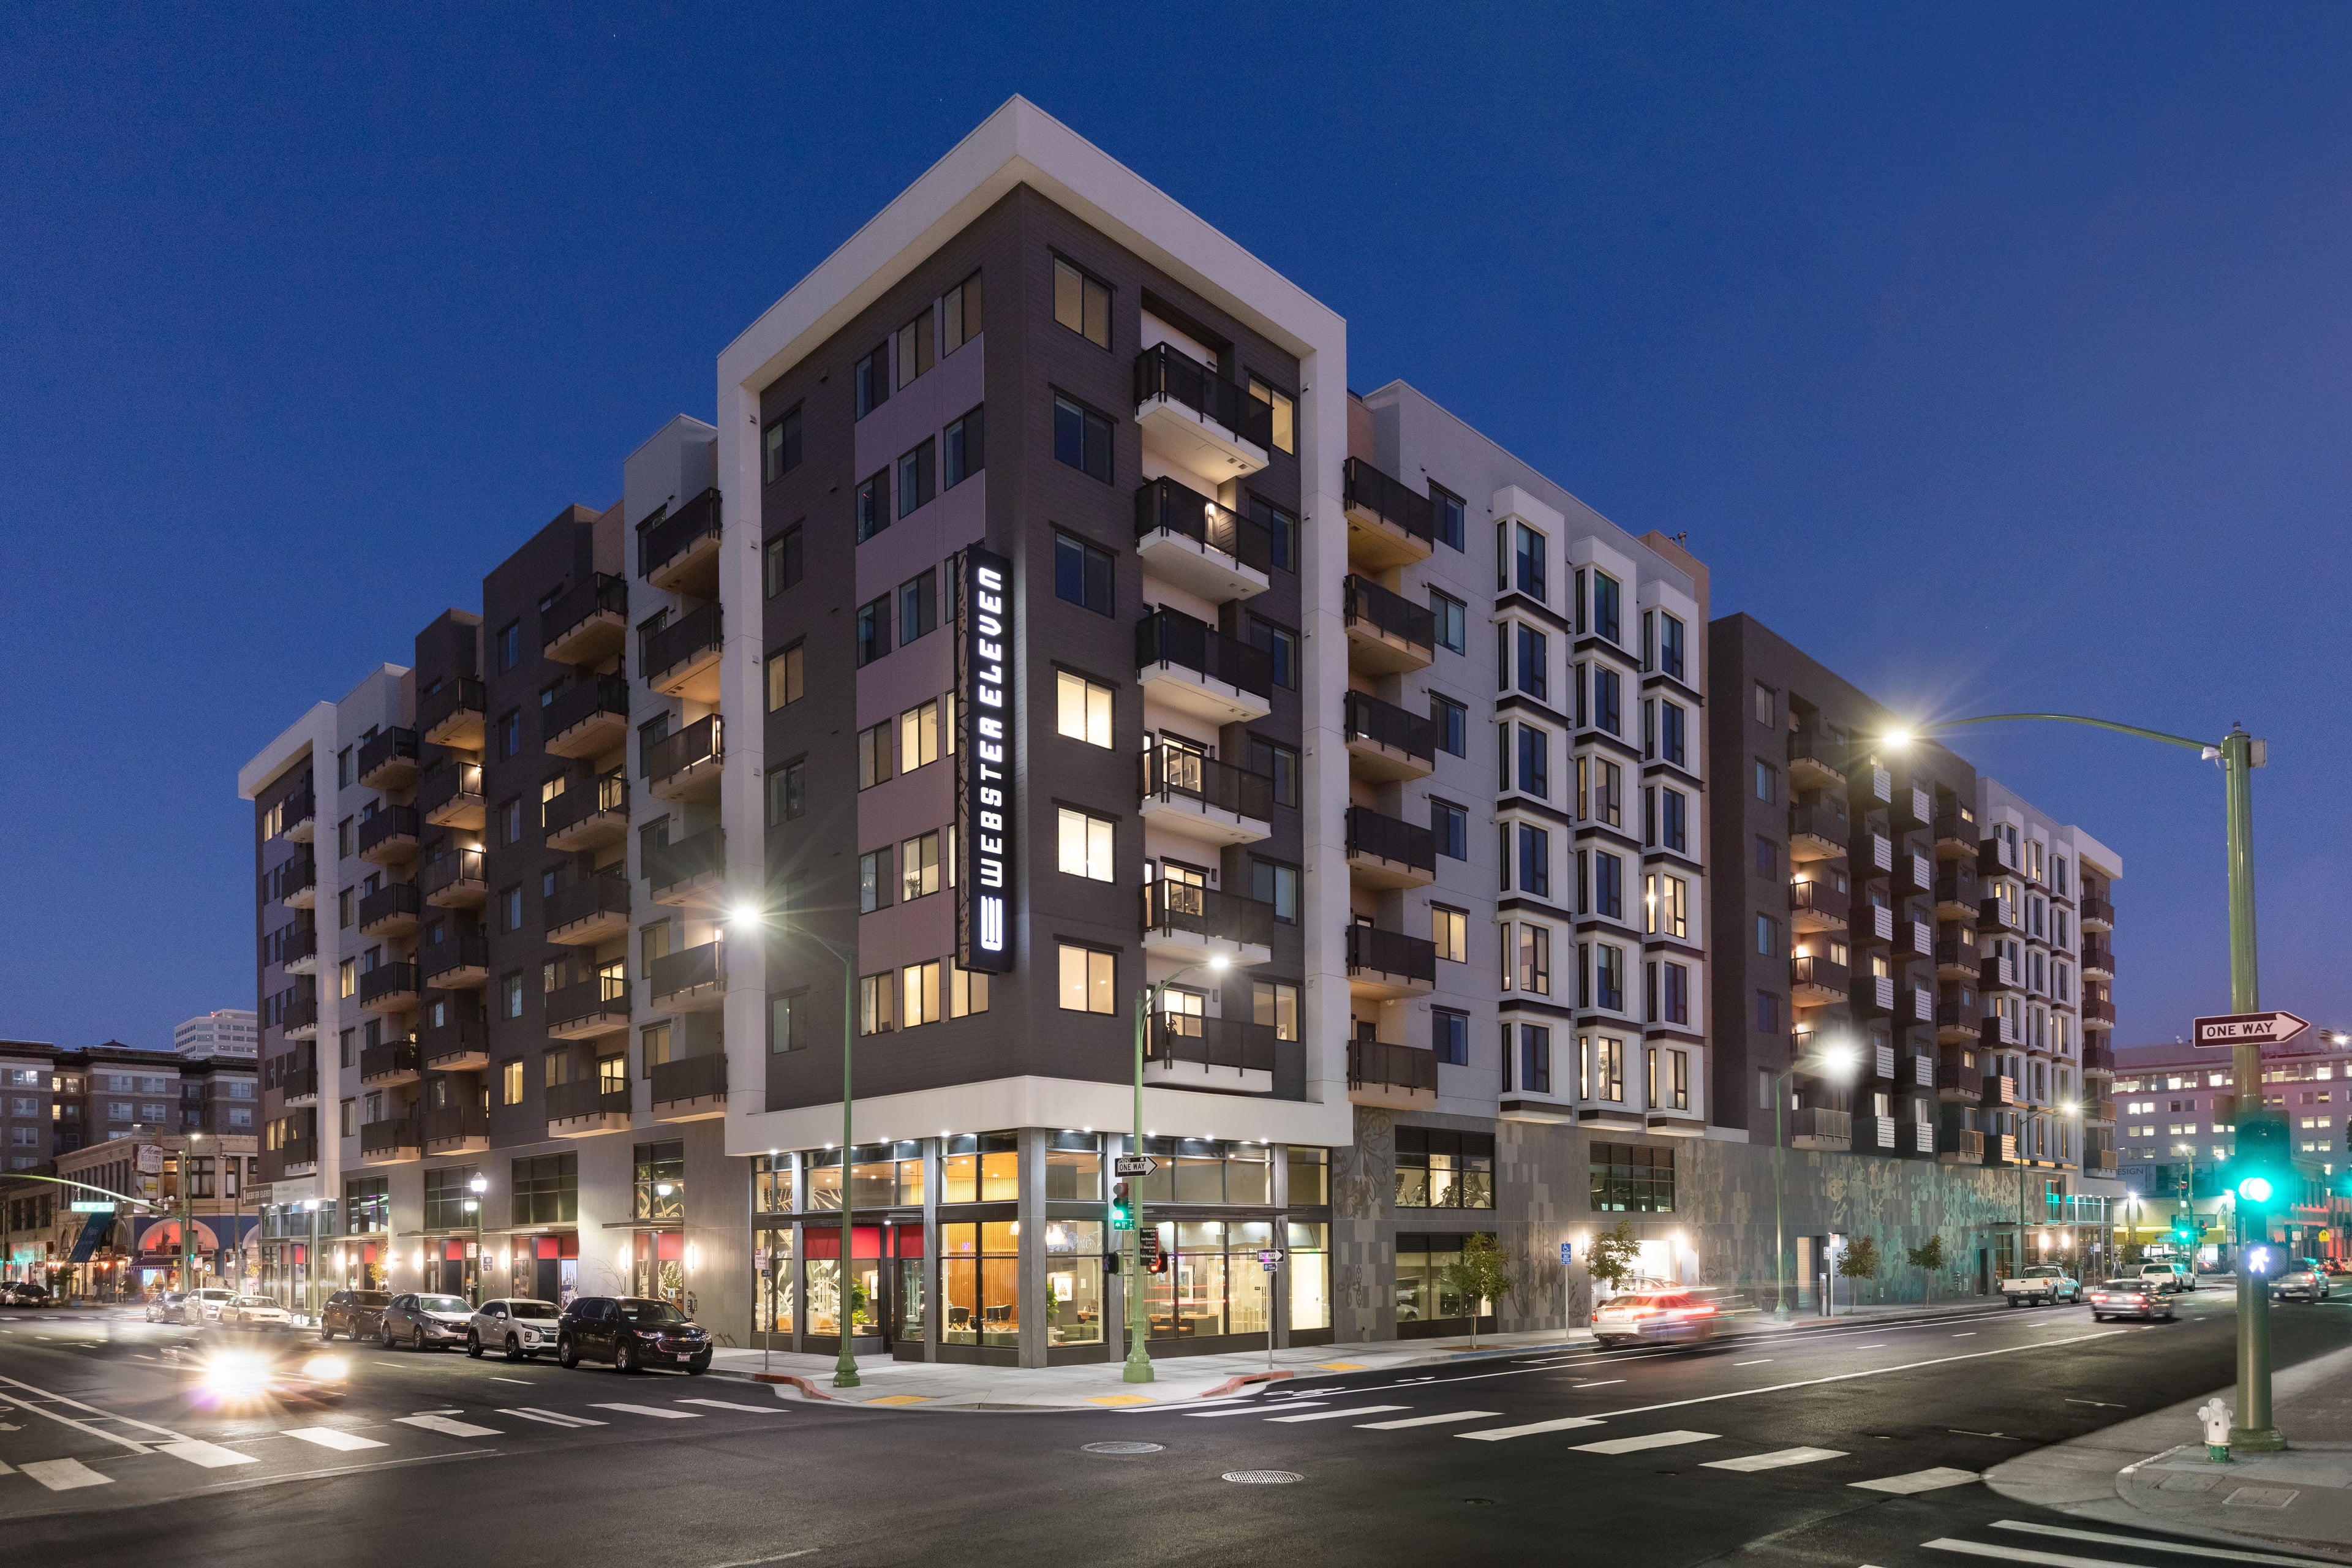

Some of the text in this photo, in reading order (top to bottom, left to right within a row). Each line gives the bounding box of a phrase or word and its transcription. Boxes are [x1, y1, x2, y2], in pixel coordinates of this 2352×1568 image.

[979, 567, 1002, 888] WEBSTER ELEVEN
[2207, 1022, 2274, 1037] ONE WAY
[141, 1155, 161, 1163] BEAUTY
[141, 1163, 161, 1172] SUPPLY
